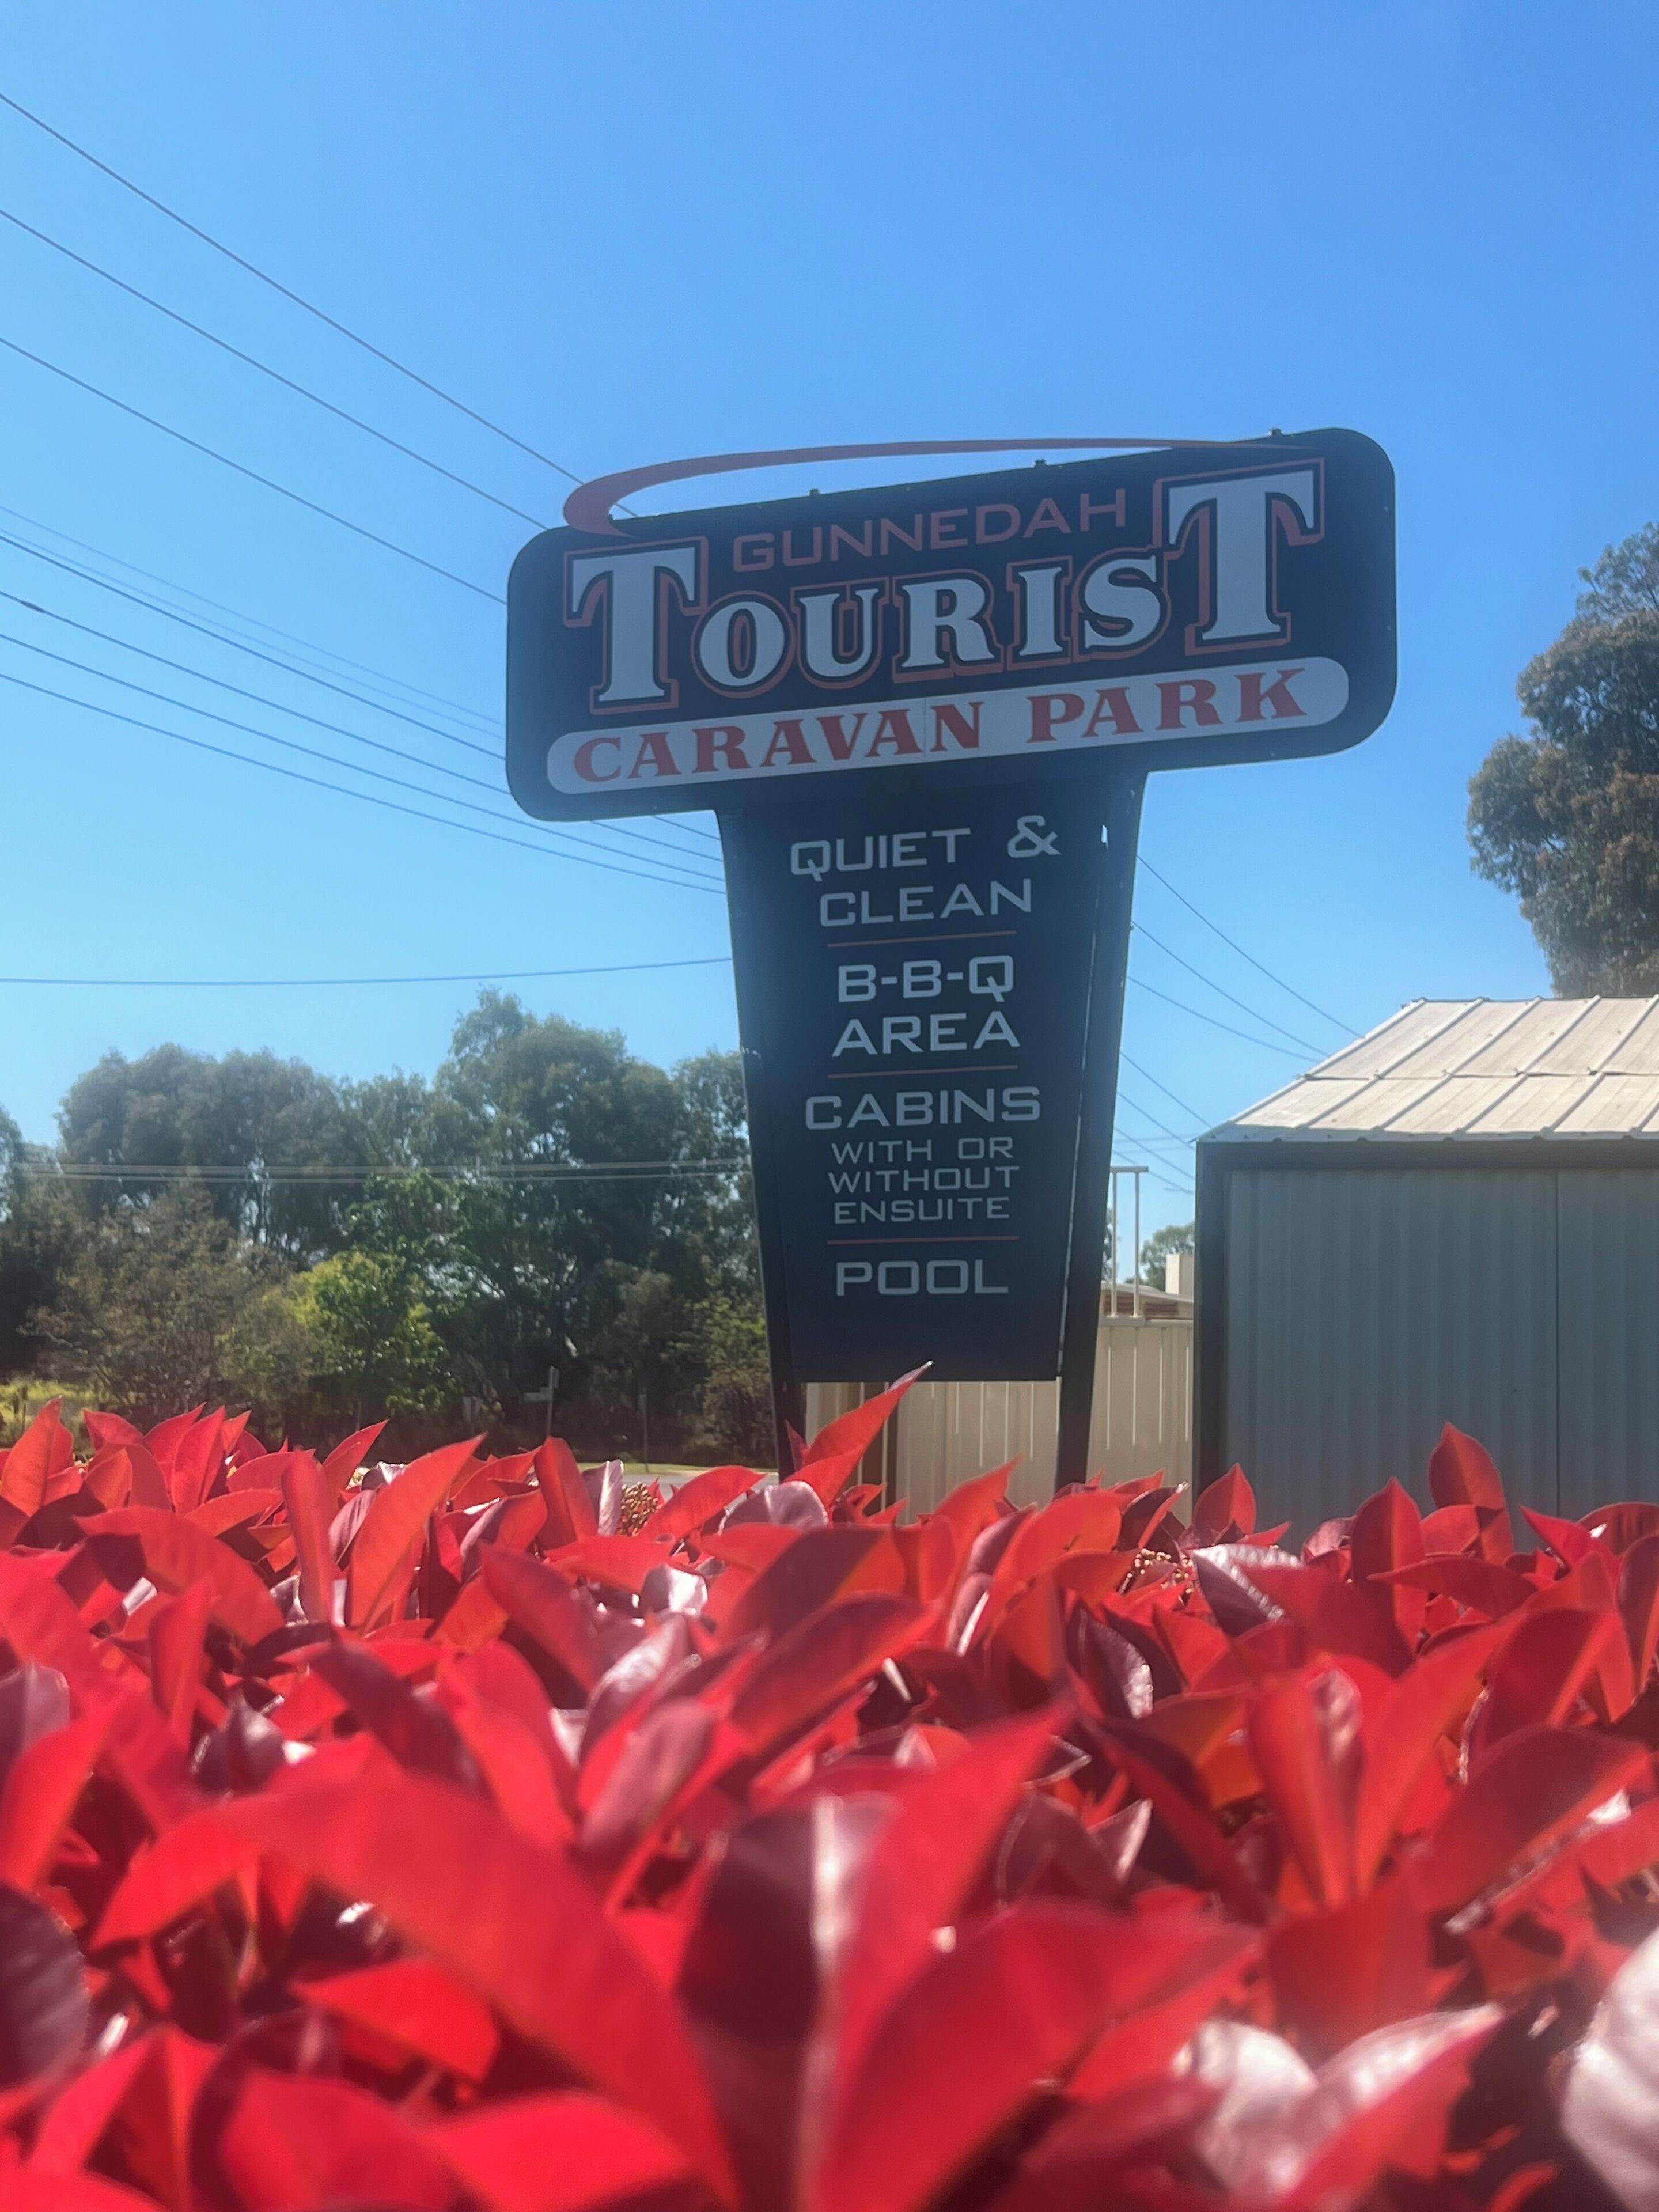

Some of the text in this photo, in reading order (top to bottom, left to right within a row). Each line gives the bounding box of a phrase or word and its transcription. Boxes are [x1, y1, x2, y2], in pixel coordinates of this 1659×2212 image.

[732, 488, 1126, 573] GUNNEDAH
[573, 666, 1308, 783] CARAVAN PARK
[790, 815, 1062, 882] QUIET &
[819, 878, 1032, 927] CLEAN
[838, 955, 1014, 1003] B-B-Q
[831, 1010, 1021, 1058] AREA
[805, 1086, 1041, 1130] CABINS
[831, 1136, 1014, 1165] WITH OR
[827, 1166, 1020, 1194] WITHOUT
[834, 1197, 1010, 1224] ENSUITE
[835, 1259, 1009, 1296] POOL
